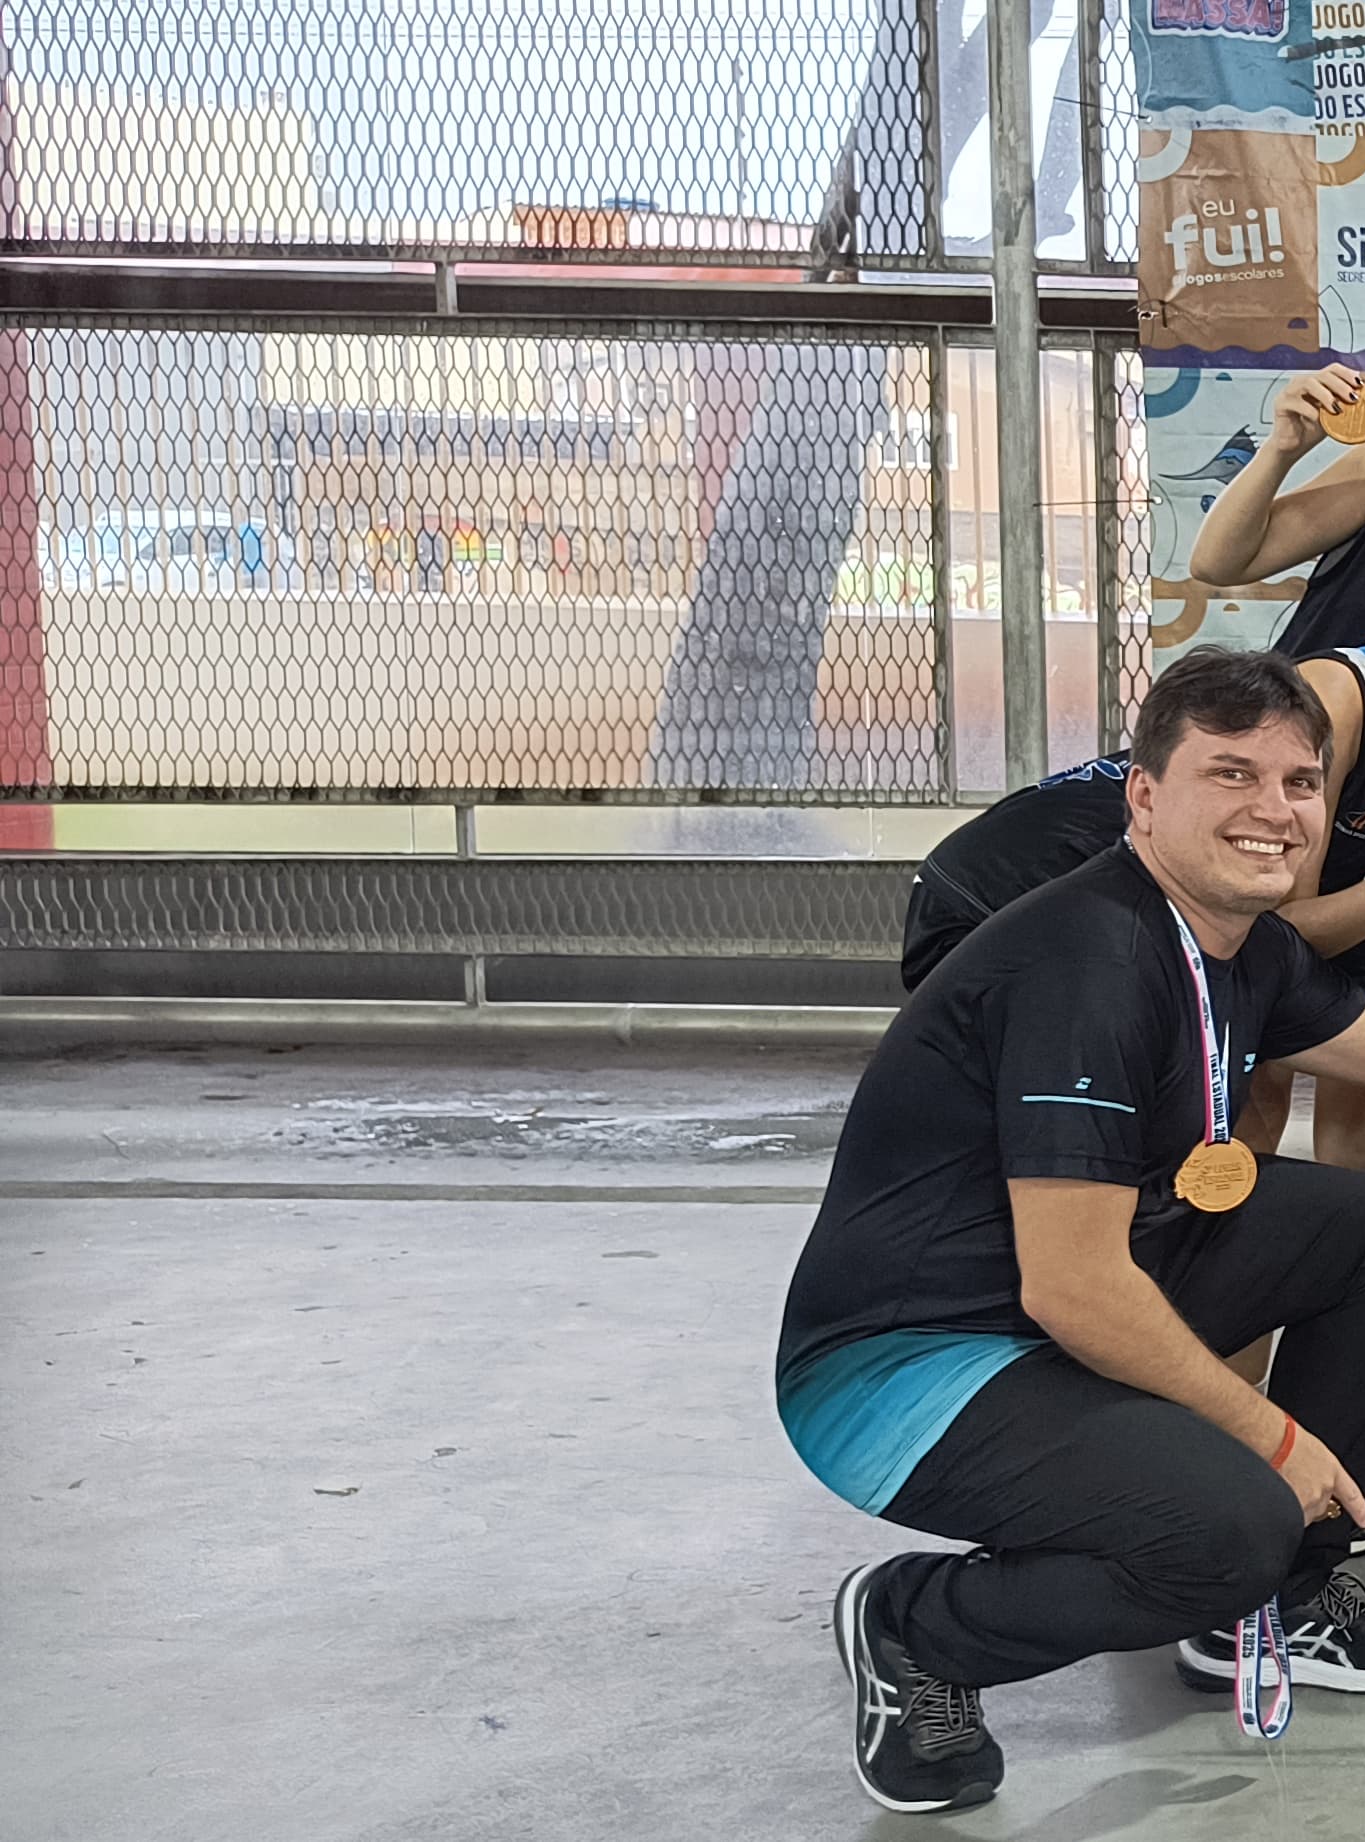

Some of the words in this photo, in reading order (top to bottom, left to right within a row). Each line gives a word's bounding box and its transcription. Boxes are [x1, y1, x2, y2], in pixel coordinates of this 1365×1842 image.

[1202, 199, 1235, 217] eu
[1164, 207, 1284, 270] fui!
[1210, 1053, 1220, 1080] FINAL
[1212, 1081, 1225, 1125] ESTADUAL
[1242, 1632, 1256, 1659] 2025
